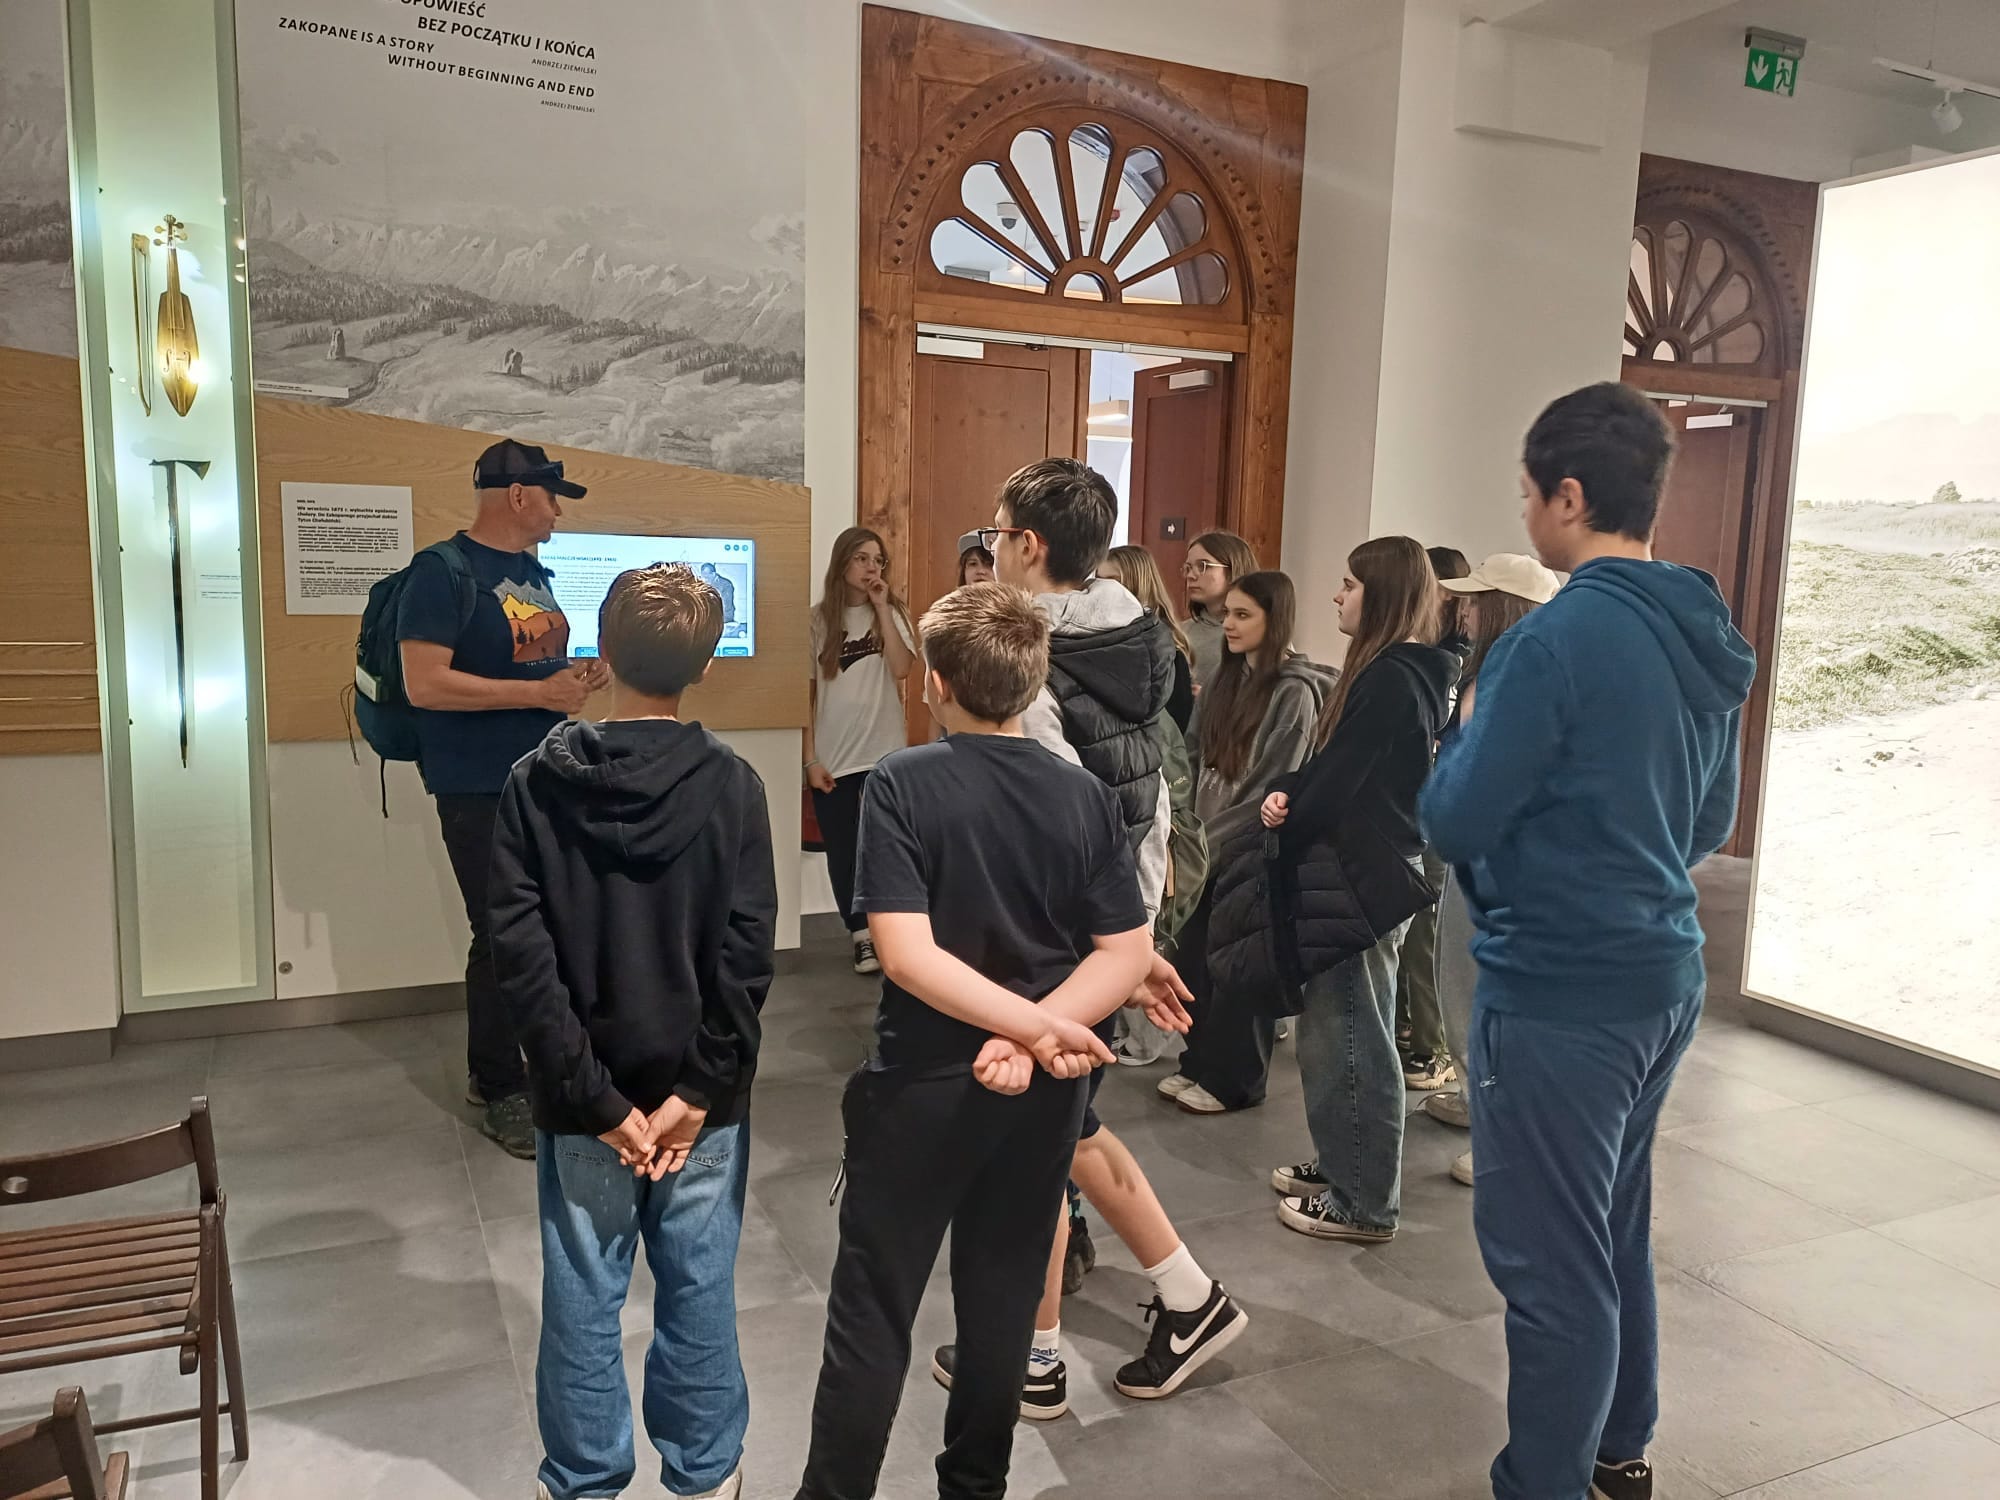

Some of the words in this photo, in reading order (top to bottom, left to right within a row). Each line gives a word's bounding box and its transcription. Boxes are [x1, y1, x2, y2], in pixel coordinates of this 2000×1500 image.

[400, 0, 486, 18] OWIEŚĆ
[278, 17, 358, 41] ZAKOPANE
[361, 31, 374, 43] IS
[376, 35, 386, 46] A
[389, 36, 435, 54] STORY
[418, 16, 447, 33] BEZ
[451, 22, 532, 47] POCZĄTKU
[535, 38, 541, 50] I
[544, 40, 596, 59] KOŃCA
[388, 53, 456, 75] WITHOUT
[458, 66, 535, 88] BEGINNING
[537, 79, 566, 93] AND
[568, 84, 595, 98] END
[531, 58, 562, 70] ANDRZEJ
[563, 63, 597, 75] ZIEMILSKI
[540, 100, 566, 109] ANDRZEJ
[567, 104, 595, 113] ZIEMILSKI
